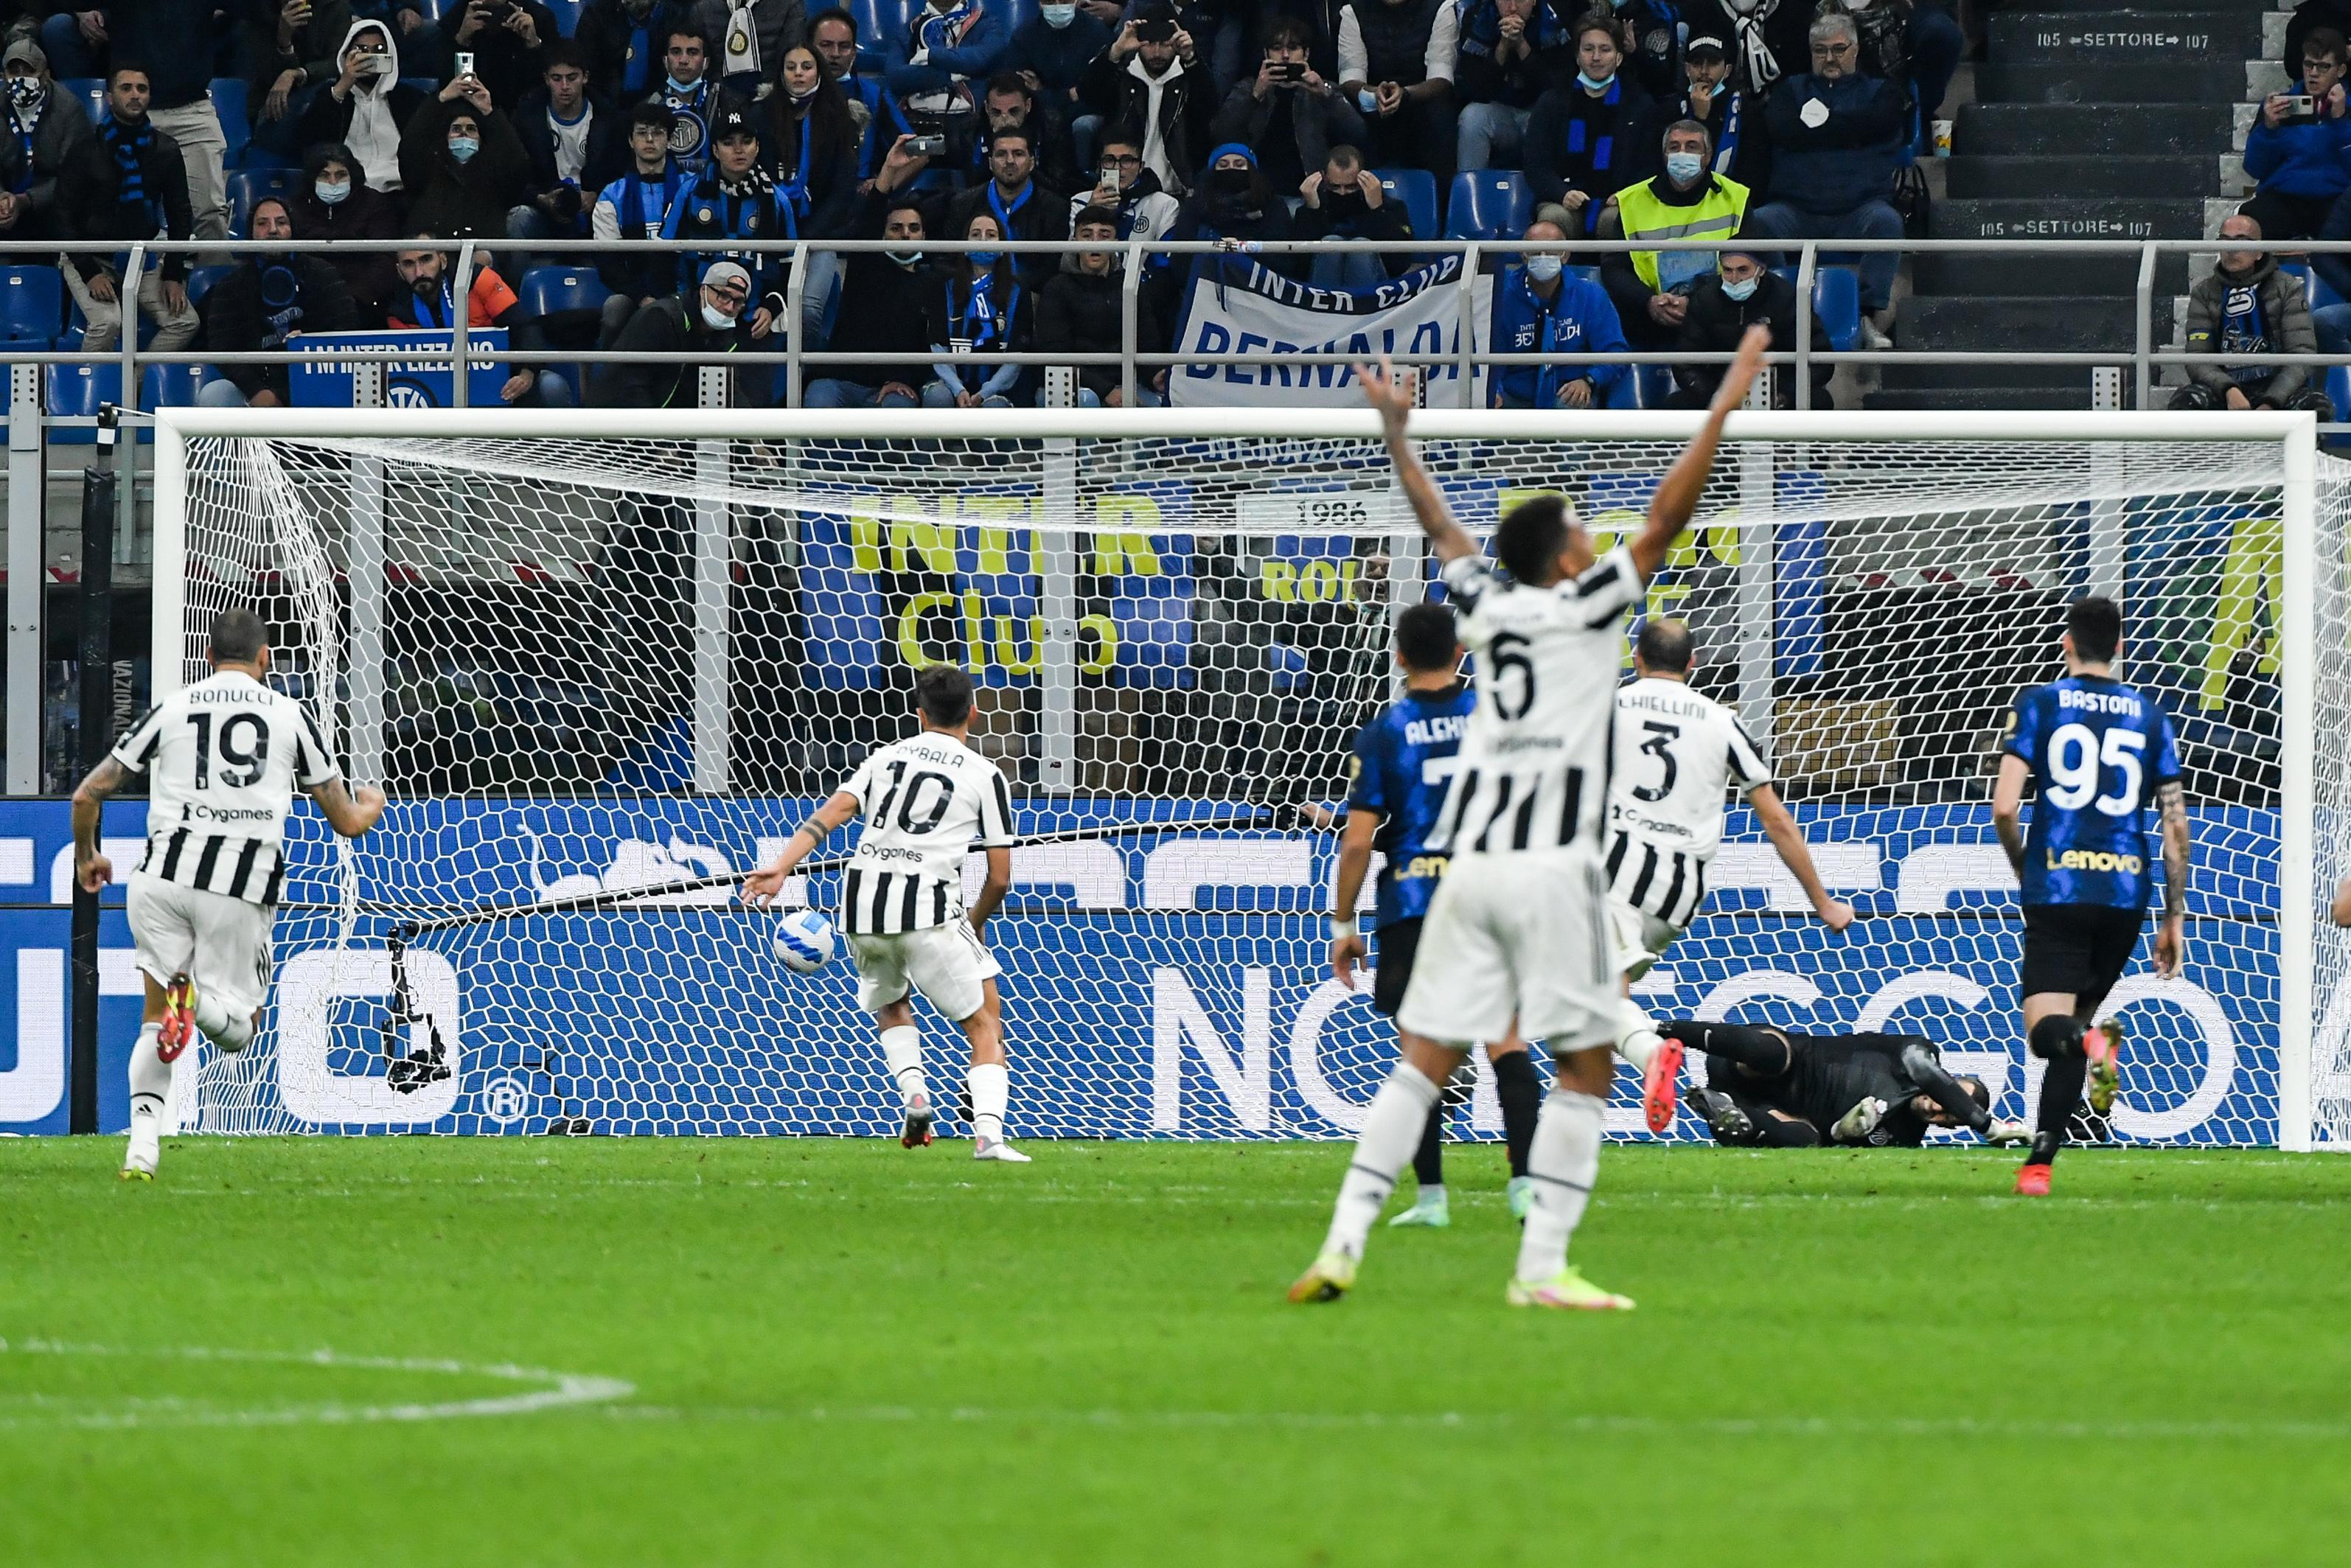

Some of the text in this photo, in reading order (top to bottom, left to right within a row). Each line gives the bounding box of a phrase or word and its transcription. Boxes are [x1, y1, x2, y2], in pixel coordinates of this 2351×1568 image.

[2038, 33, 2209, 49] 105 SETTORE 107
[1981, 220, 2152, 236] 105 SETTORE 107
[1248, 261, 1354, 312] INTER
[340, 344, 402, 373] INR
[405, 341, 495, 372] LIZZNO
[1296, 501, 1368, 526] 1986
[1490, 631, 1534, 721] 6
[112, 660, 133, 744] NAZIONAL
[189, 689, 274, 706] BONUCCI
[2058, 689, 2142, 718] BASTONI
[187, 712, 270, 790] 19
[1631, 719, 1680, 802] 3
[2045, 722, 2147, 818] 95
[872, 759, 955, 835] 10
[195, 804, 274, 823] Cygames
[2047, 846, 2142, 876] Lenovo
